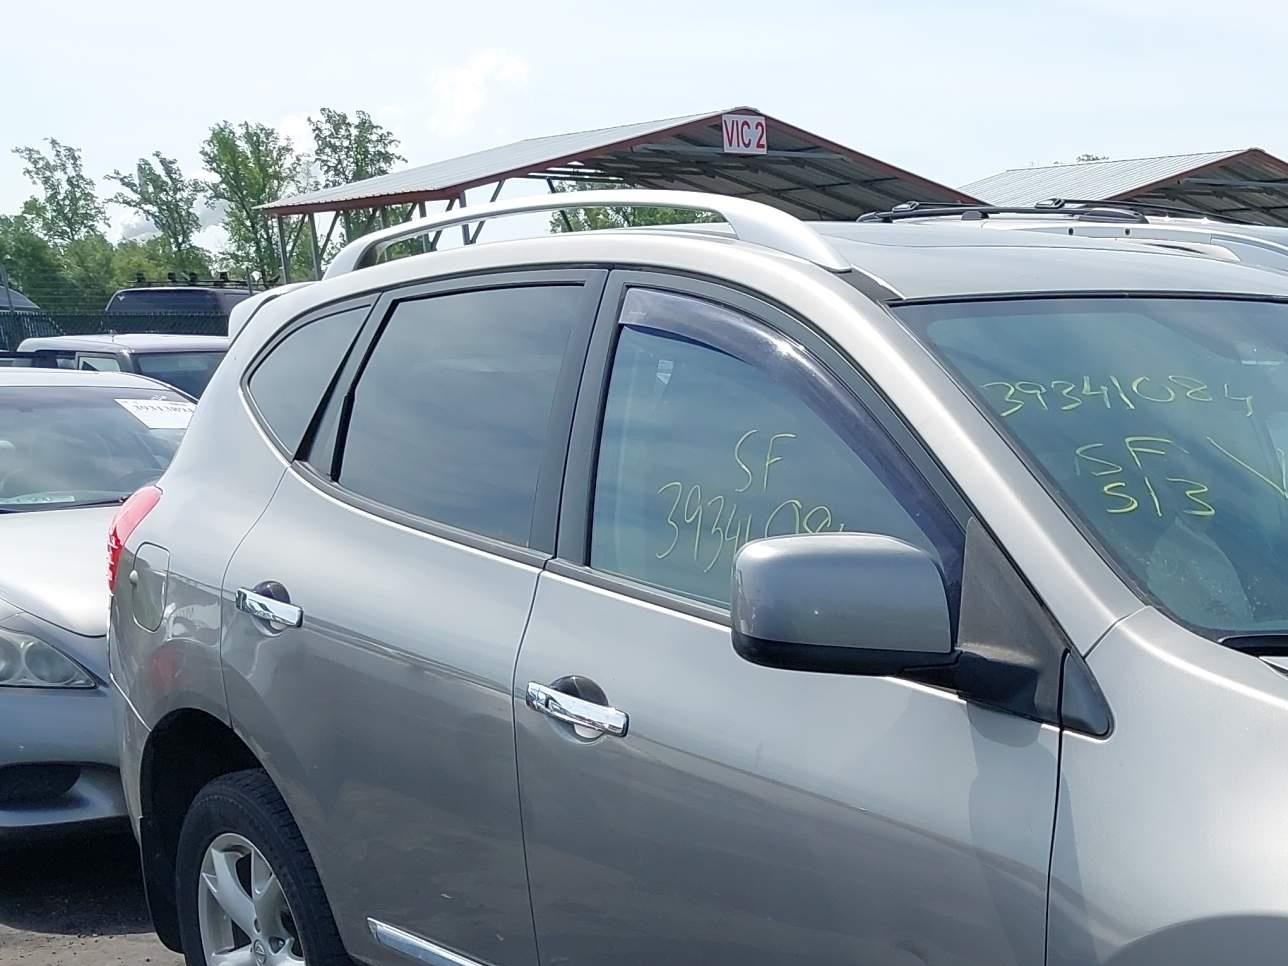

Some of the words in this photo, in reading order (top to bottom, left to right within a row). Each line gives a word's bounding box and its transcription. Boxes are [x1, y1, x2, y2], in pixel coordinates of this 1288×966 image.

[723, 119, 752, 149] VIC
[755, 121, 766, 149] 2
[981, 376, 1253, 417] 39341084
[734, 430, 797, 493] SF
[1074, 437, 1178, 476] SF
